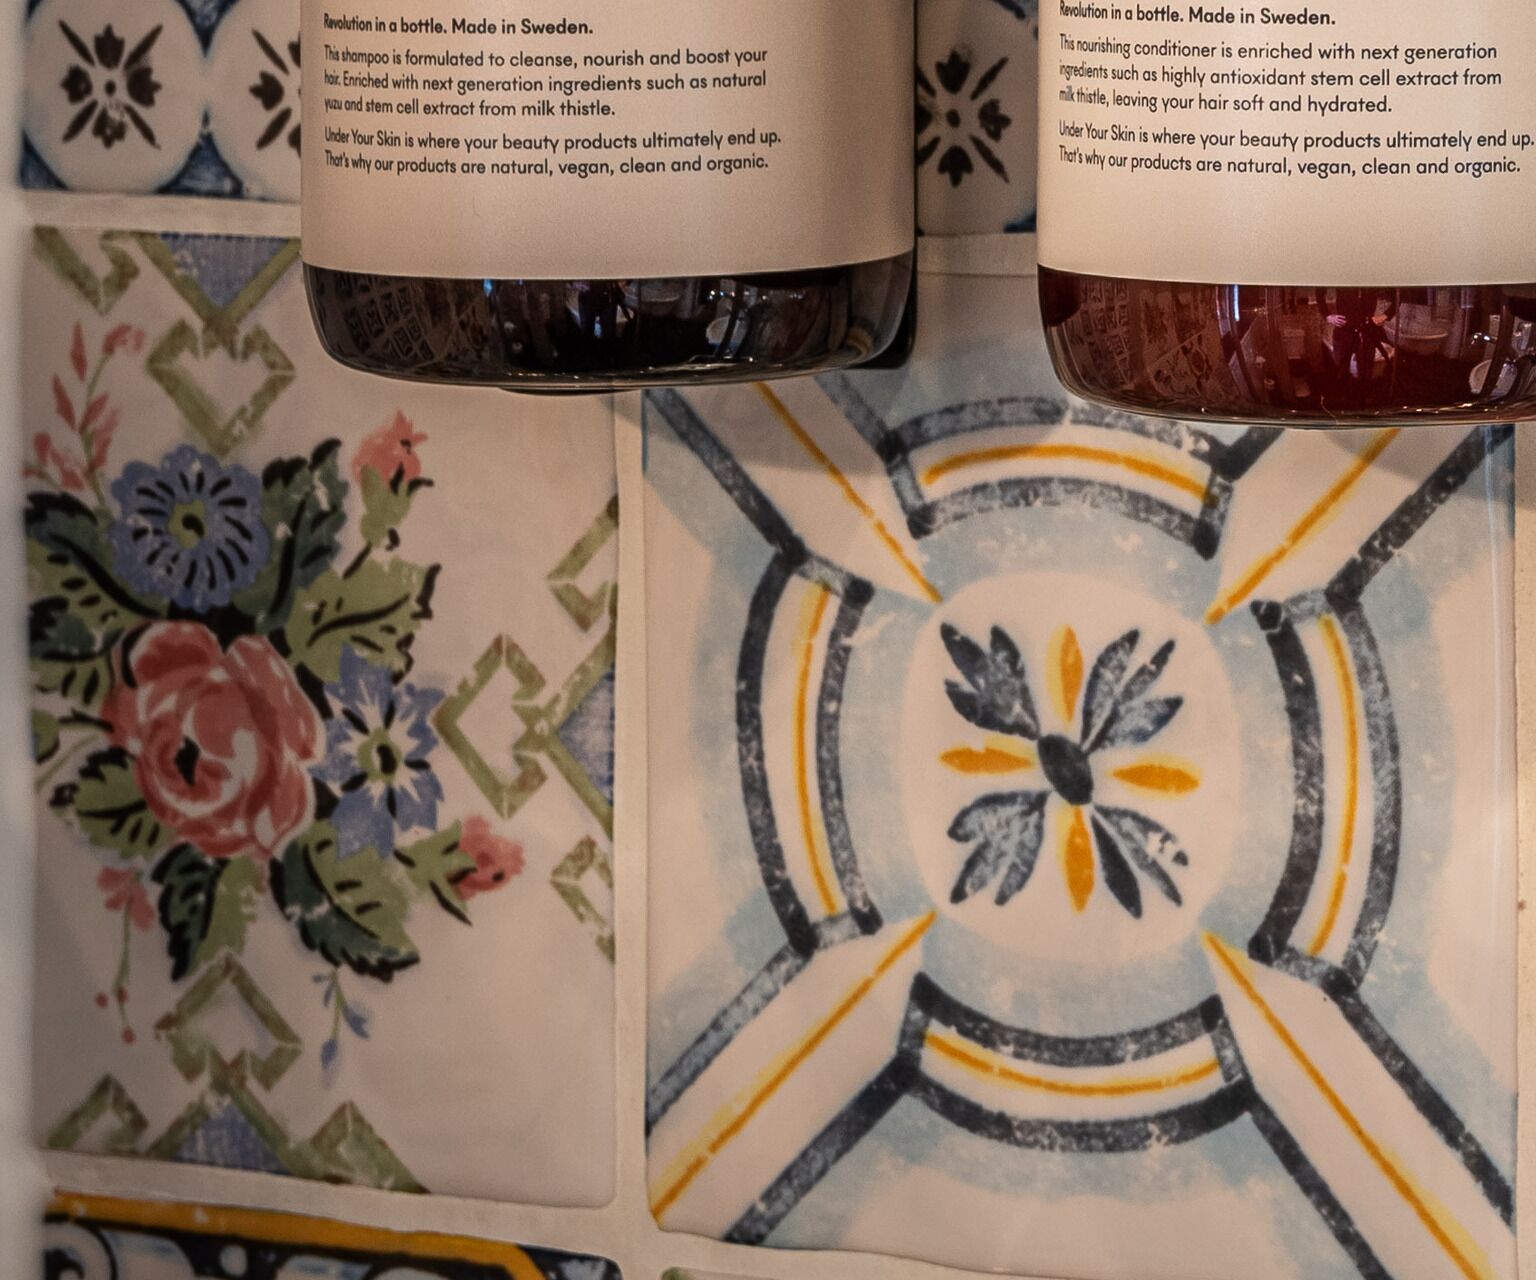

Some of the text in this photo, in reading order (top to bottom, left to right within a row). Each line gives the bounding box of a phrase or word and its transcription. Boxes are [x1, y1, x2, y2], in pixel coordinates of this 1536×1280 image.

[388, 17, 594, 35] a Made in Sweden.
[1124, 6, 1336, 25] a Made in Sweden.
[487, 48, 768, 70] to cleanse, nourish and boost your
[1134, 38, 1497, 65] conditioner enriched with next generation
[457, 69, 766, 97] generation ingredients such as natural
[1161, 64, 1502, 89] highly antioxidant stem cell extract from
[478, 98, 616, 117] from milk thistle.
[1161, 92, 1392, 118] your hair soft and hydrated.
[463, 127, 756, 155] your beauty products ultimately end
[1199, 128, 1535, 153] your beauty products ultimately end up.
[460, 152, 769, 179] are natural, vegan, clean and organic.
[1196, 155, 1521, 179] are natural, vegan, clean and organic.
